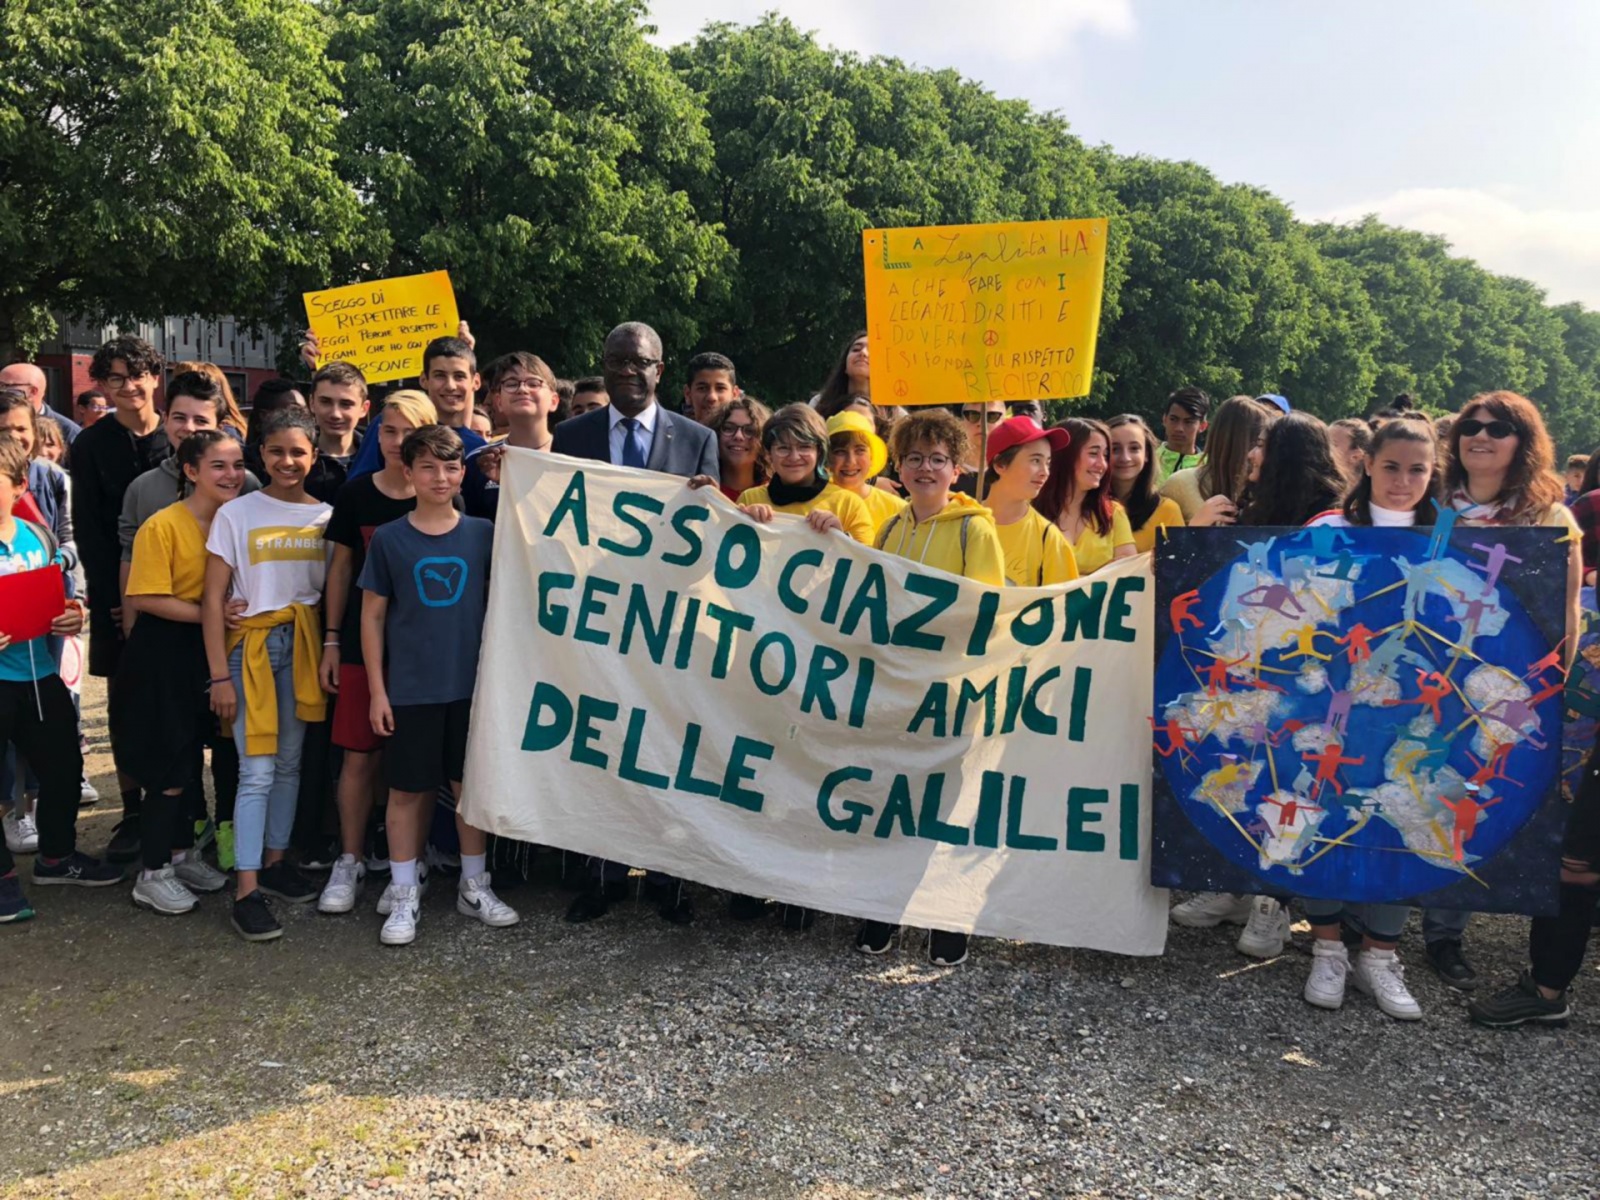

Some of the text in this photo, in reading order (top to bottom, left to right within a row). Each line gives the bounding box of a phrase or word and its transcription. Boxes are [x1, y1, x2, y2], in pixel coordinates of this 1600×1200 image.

[1059, 230, 1089, 258] HA
[889, 273, 1066, 298] A CHE FARE CON I
[334, 304, 441, 330] RISPETTARE LE
[1057, 300, 1070, 322] E
[366, 343, 385, 354] CHE
[390, 343, 403, 351] HO
[875, 323, 966, 349] I DOVERI
[899, 350, 917, 369] SI
[1011, 347, 1075, 369] RISPETTO
[964, 370, 1083, 398] RECIPROCO
[542, 470, 1146, 657] ASSOCIAZIONE
[536, 571, 1092, 743] GENITORI AMICI
[520, 681, 1140, 861] DELLE GALILEI
